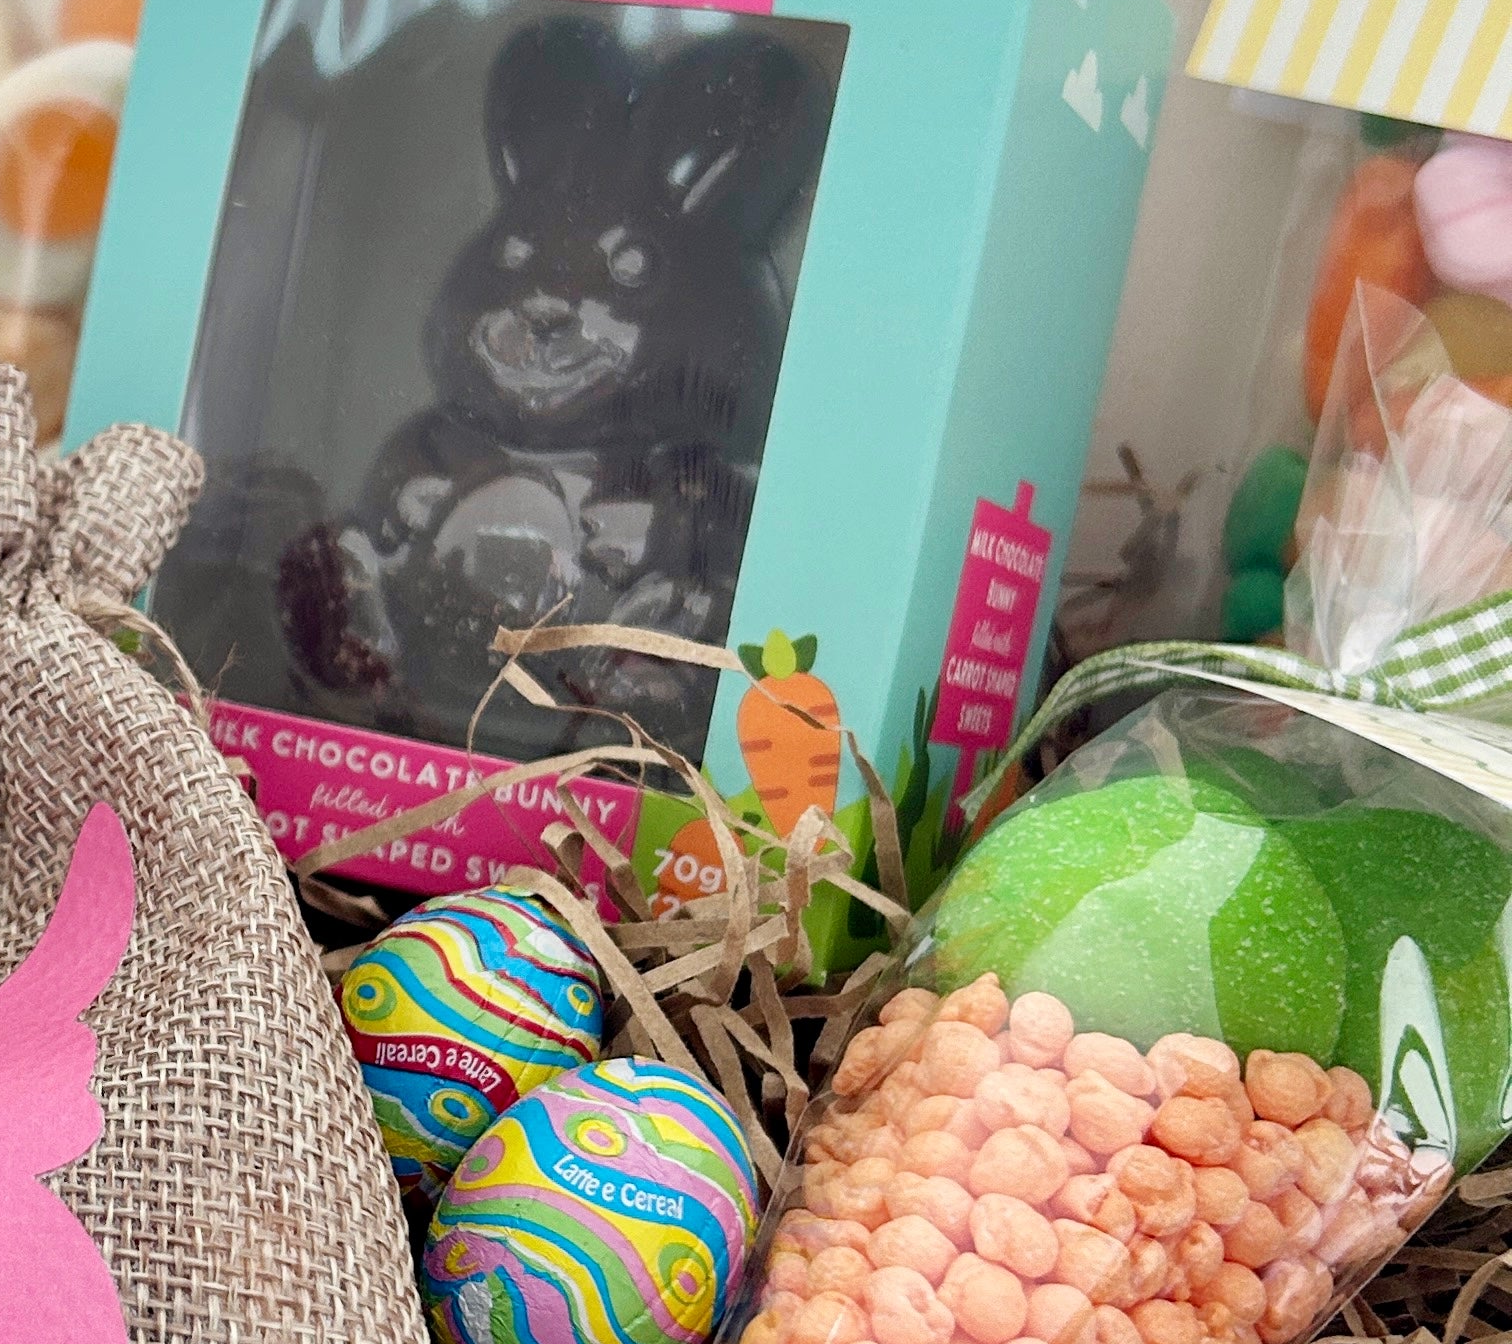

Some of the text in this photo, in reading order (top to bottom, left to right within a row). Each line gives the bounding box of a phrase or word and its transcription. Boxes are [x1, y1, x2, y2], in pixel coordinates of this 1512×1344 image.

[271, 729, 483, 793] CHOCOLATE
[653, 848, 723, 894] 70g
[374, 1041, 503, 1094] Latte e Cereali
[552, 1153, 686, 1221] Latte e Cereal
